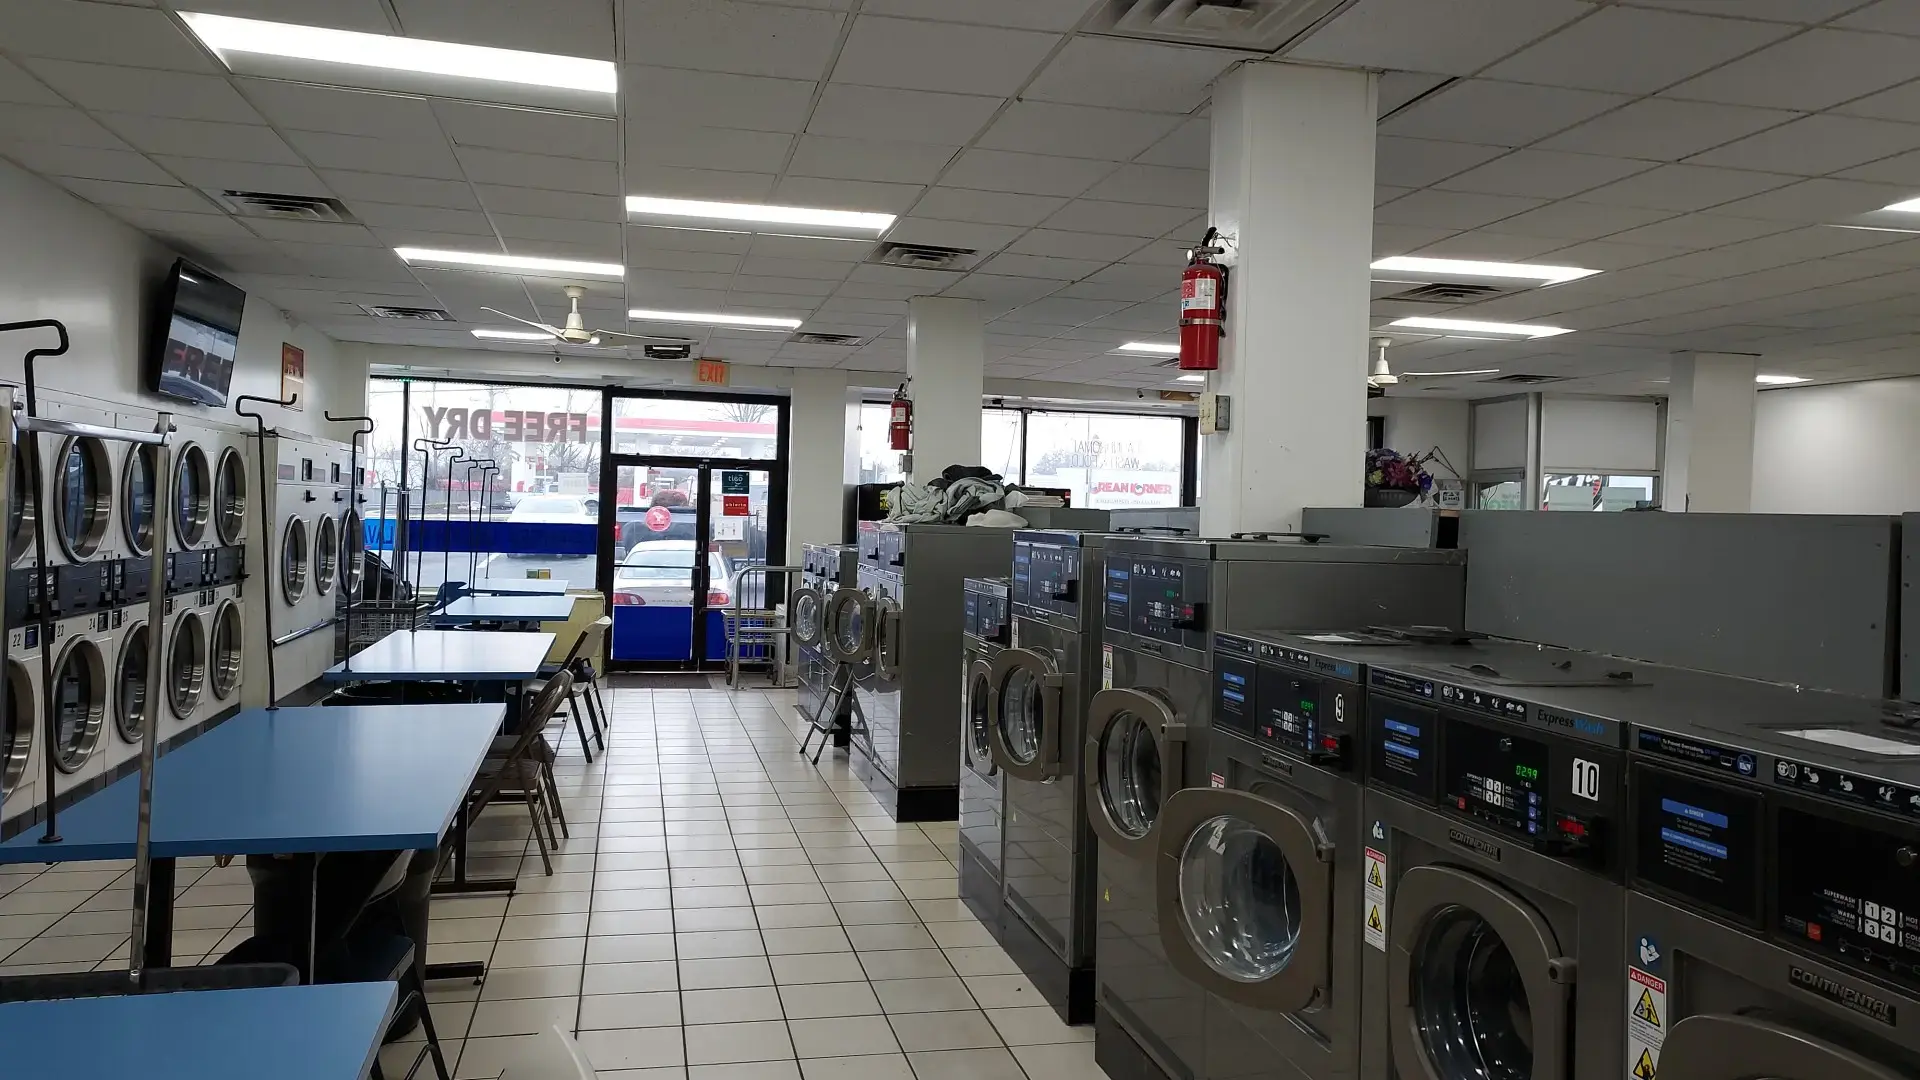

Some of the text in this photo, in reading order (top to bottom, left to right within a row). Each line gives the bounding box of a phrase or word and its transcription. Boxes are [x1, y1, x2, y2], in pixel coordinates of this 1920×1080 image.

[699, 362, 725, 384] EXIT
[57, 624, 65, 637] 23
[89, 618, 96, 630] 24
[12, 633, 22, 647] 22
[1537, 709, 1606, 735] ExpressWash
[1576, 761, 1598, 799] 10
[1824, 889, 1855, 904] SUPERWASH
[1837, 909, 1855, 920] WARM
[1905, 915, 1918, 925] HOT
[1885, 931, 1892, 941] 4
[1636, 972, 1664, 991] DANGER
[1791, 967, 1889, 1017] CONTINENTAL
